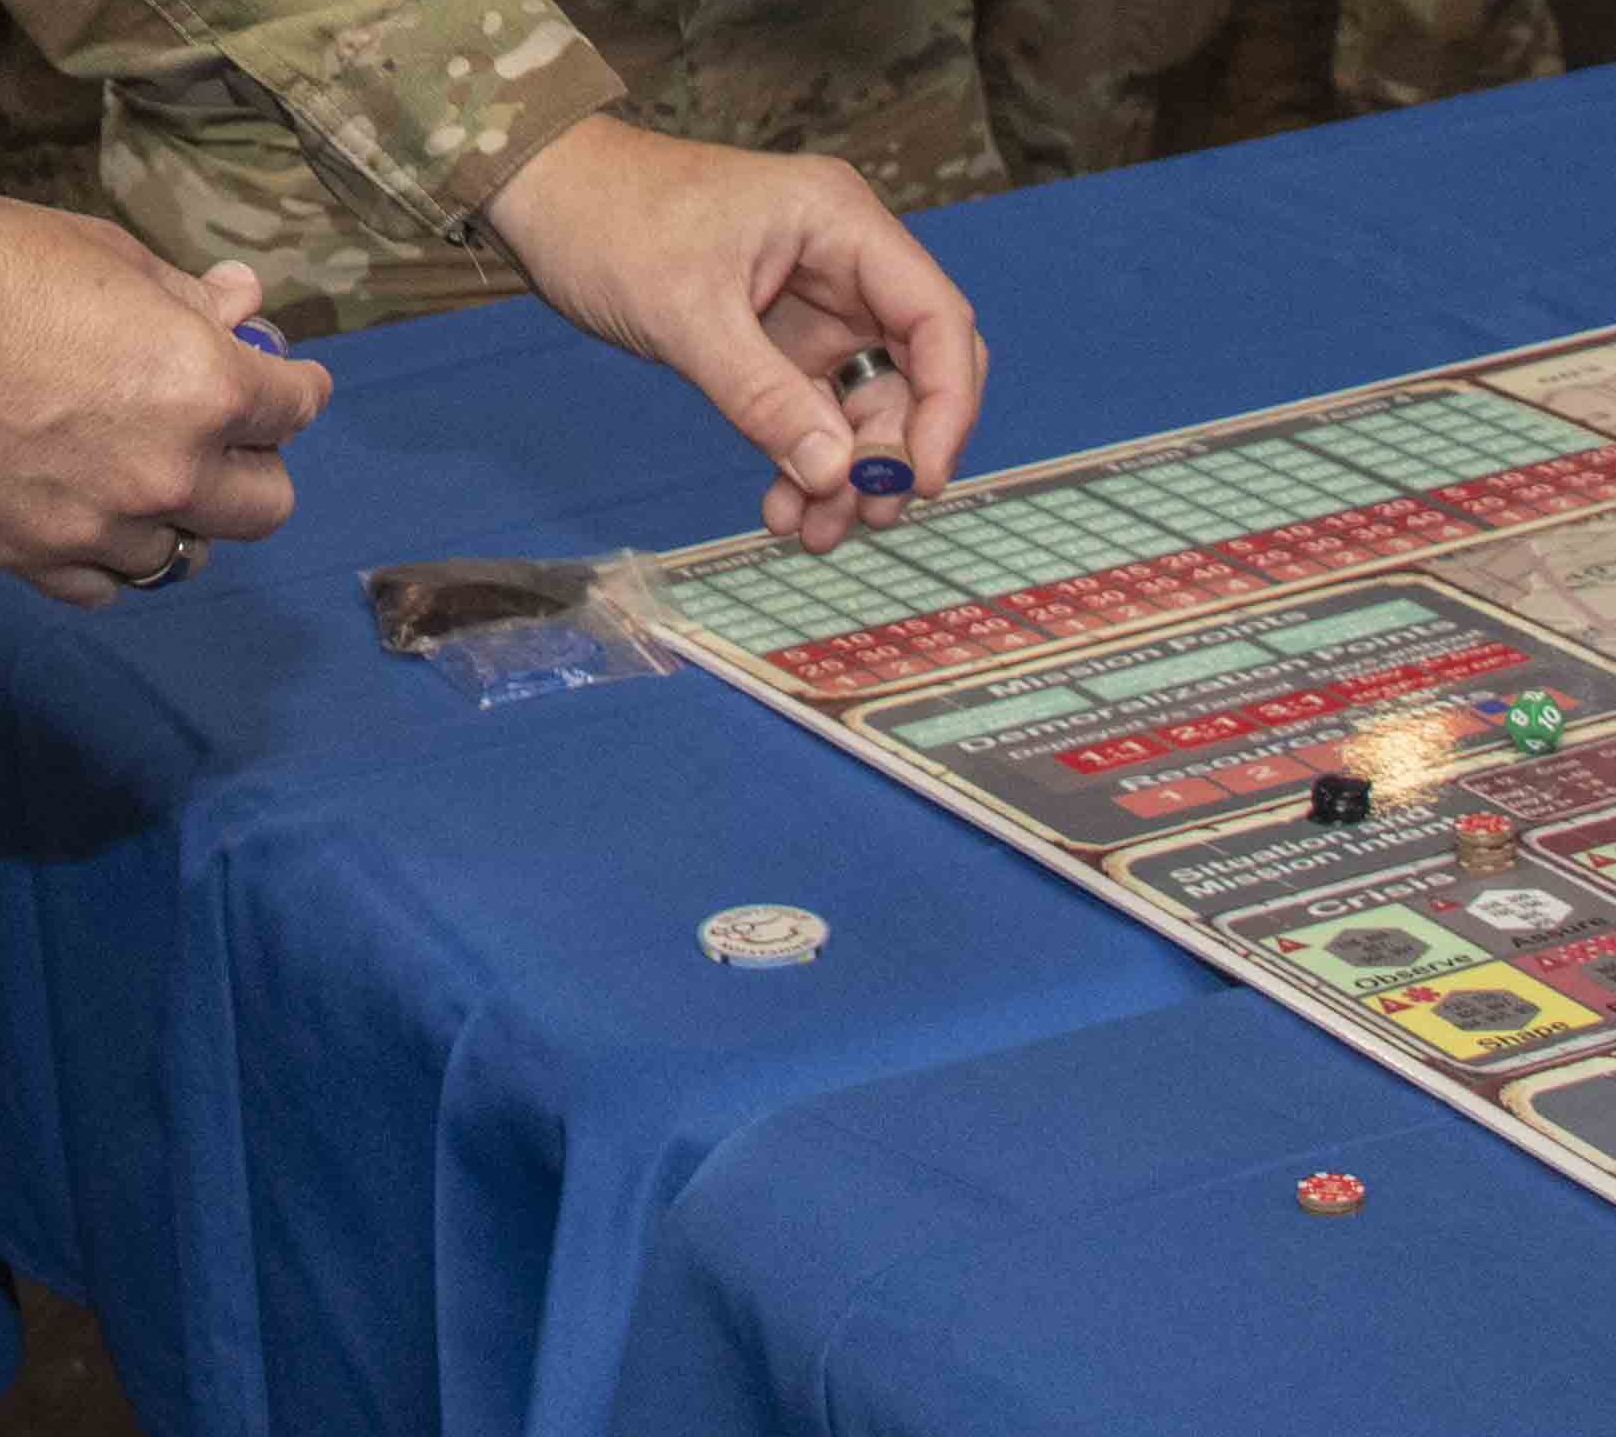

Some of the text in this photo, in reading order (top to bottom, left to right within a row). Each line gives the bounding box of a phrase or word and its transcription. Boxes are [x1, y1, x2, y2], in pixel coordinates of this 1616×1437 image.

[985, 608, 1313, 697] Mission Points
[956, 656, 1315, 754] Demoralization
[1315, 617, 1461, 660] Points
[1256, 694, 1327, 717] 3:1
[1170, 716, 1241, 740] 2:1
[1538, 704, 1563, 732] 10
[1078, 741, 1147, 764] 1:1
[1118, 726, 1349, 791] Resource
[1169, 827, 1362, 883] Situation
[1183, 847, 1352, 897] Mission
[1302, 870, 1461, 919] Crisis
[1506, 915, 1613, 948] Assure
[1350, 951, 1478, 991] Observe
[1473, 1018, 1574, 1052] Shape
